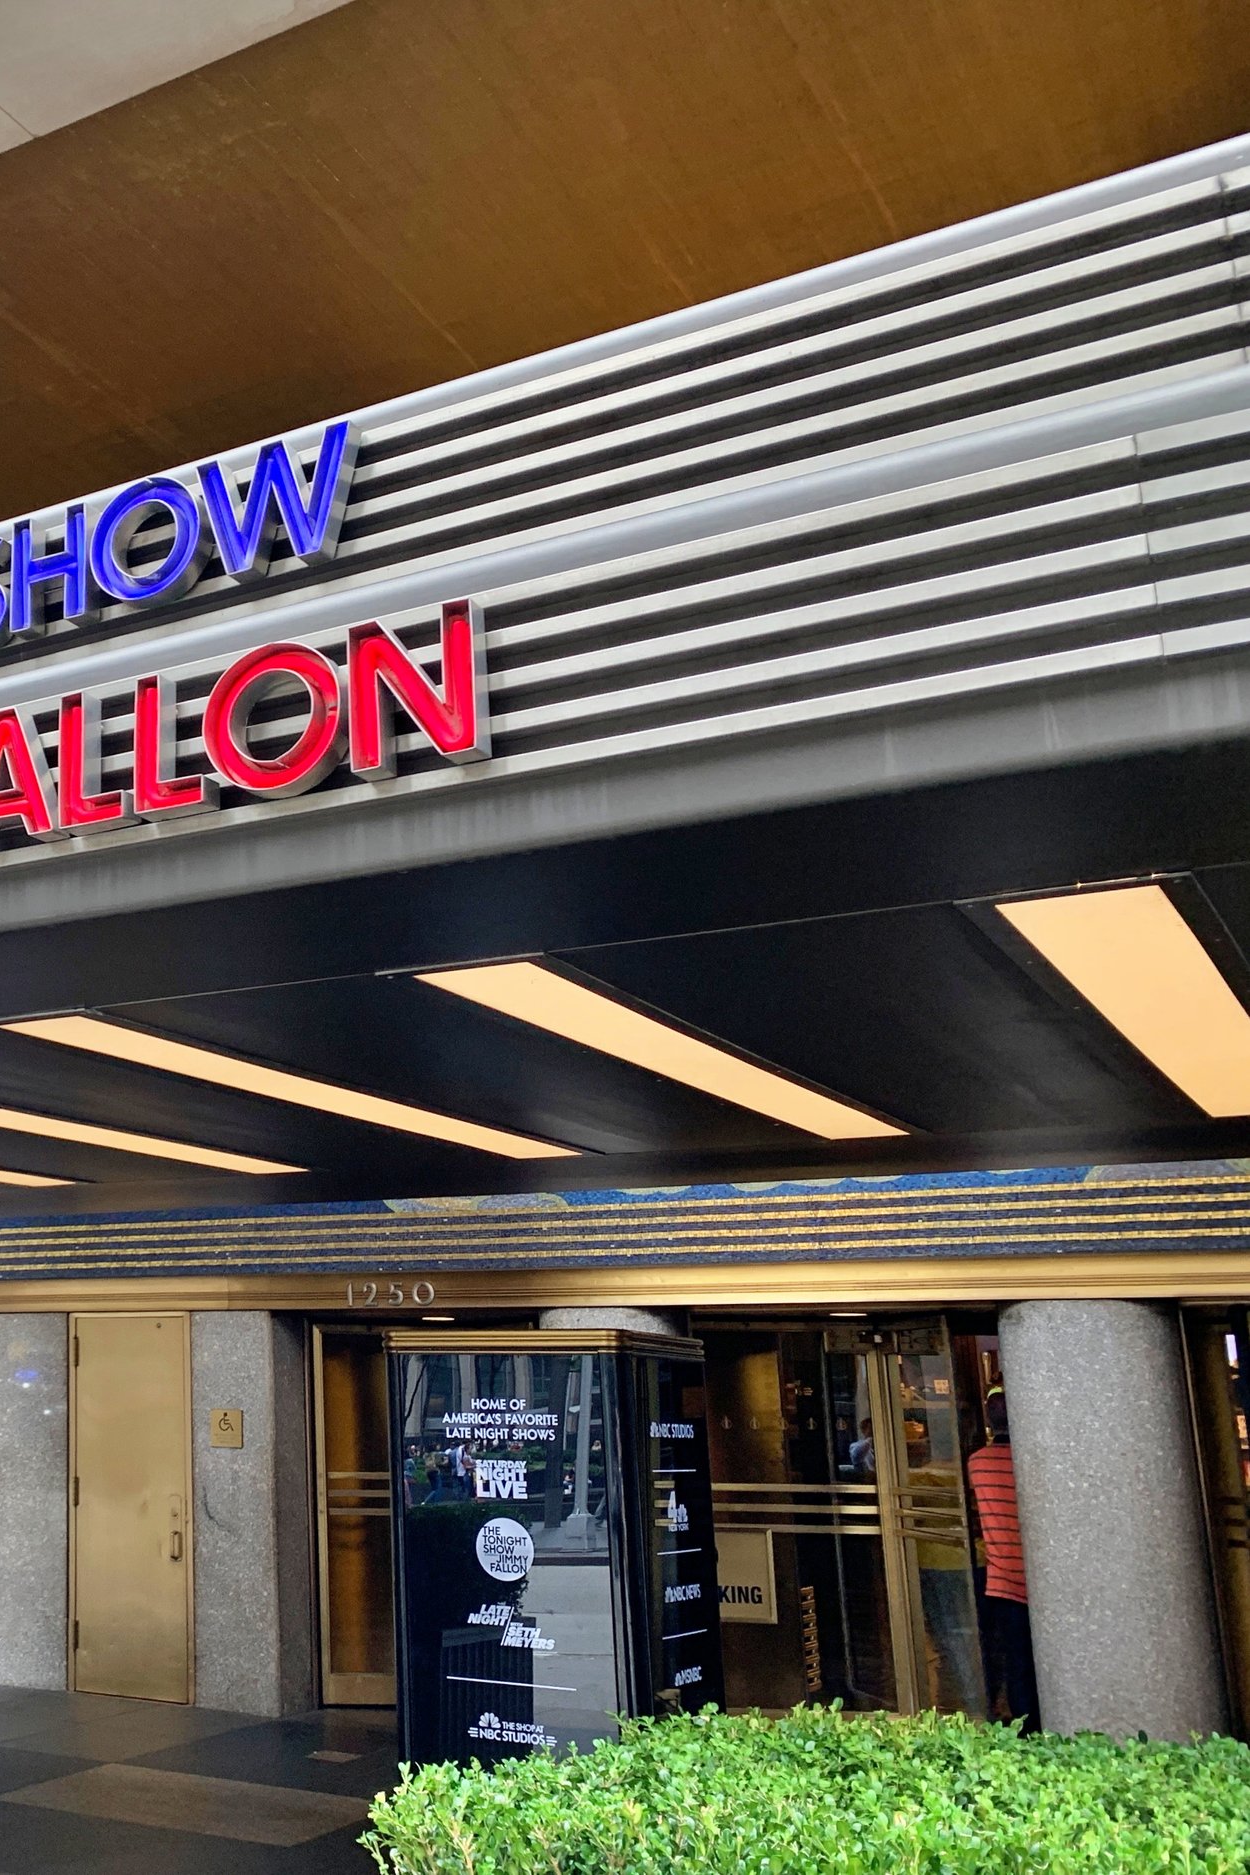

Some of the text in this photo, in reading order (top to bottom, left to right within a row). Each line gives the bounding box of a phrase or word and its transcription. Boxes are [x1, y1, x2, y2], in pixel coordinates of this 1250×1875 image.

[347, 1281, 435, 1307] 1250
[471, 1398, 527, 1411] HOME OF
[442, 1412, 559, 1426] AMERICA'S FAVORITE
[445, 1426, 556, 1441] LATE NIGHT SHOWS
[658, 1423, 694, 1439] NBC STUDIOS
[475, 1459, 527, 1469] SATURDAY
[476, 1467, 527, 1482] NIGHT
[476, 1480, 528, 1499] LIVE
[482, 1526, 501, 1536] THE
[678, 1522, 689, 1531] YORK
[483, 1535, 528, 1547] TONIGHT
[483, 1544, 515, 1555] SHOW
[496, 1555, 529, 1565] JIMMY
[490, 1563, 528, 1574] FALLON
[672, 1586, 687, 1602] NBC
[479, 1604, 511, 1616] LATE
[467, 1613, 509, 1626] NIGHT
[507, 1626, 541, 1638] SETH
[503, 1636, 556, 1650] MEYERS
[502, 1721, 544, 1733] THE SHOP AT
[479, 1728, 545, 1745] NBC STUDIOS
